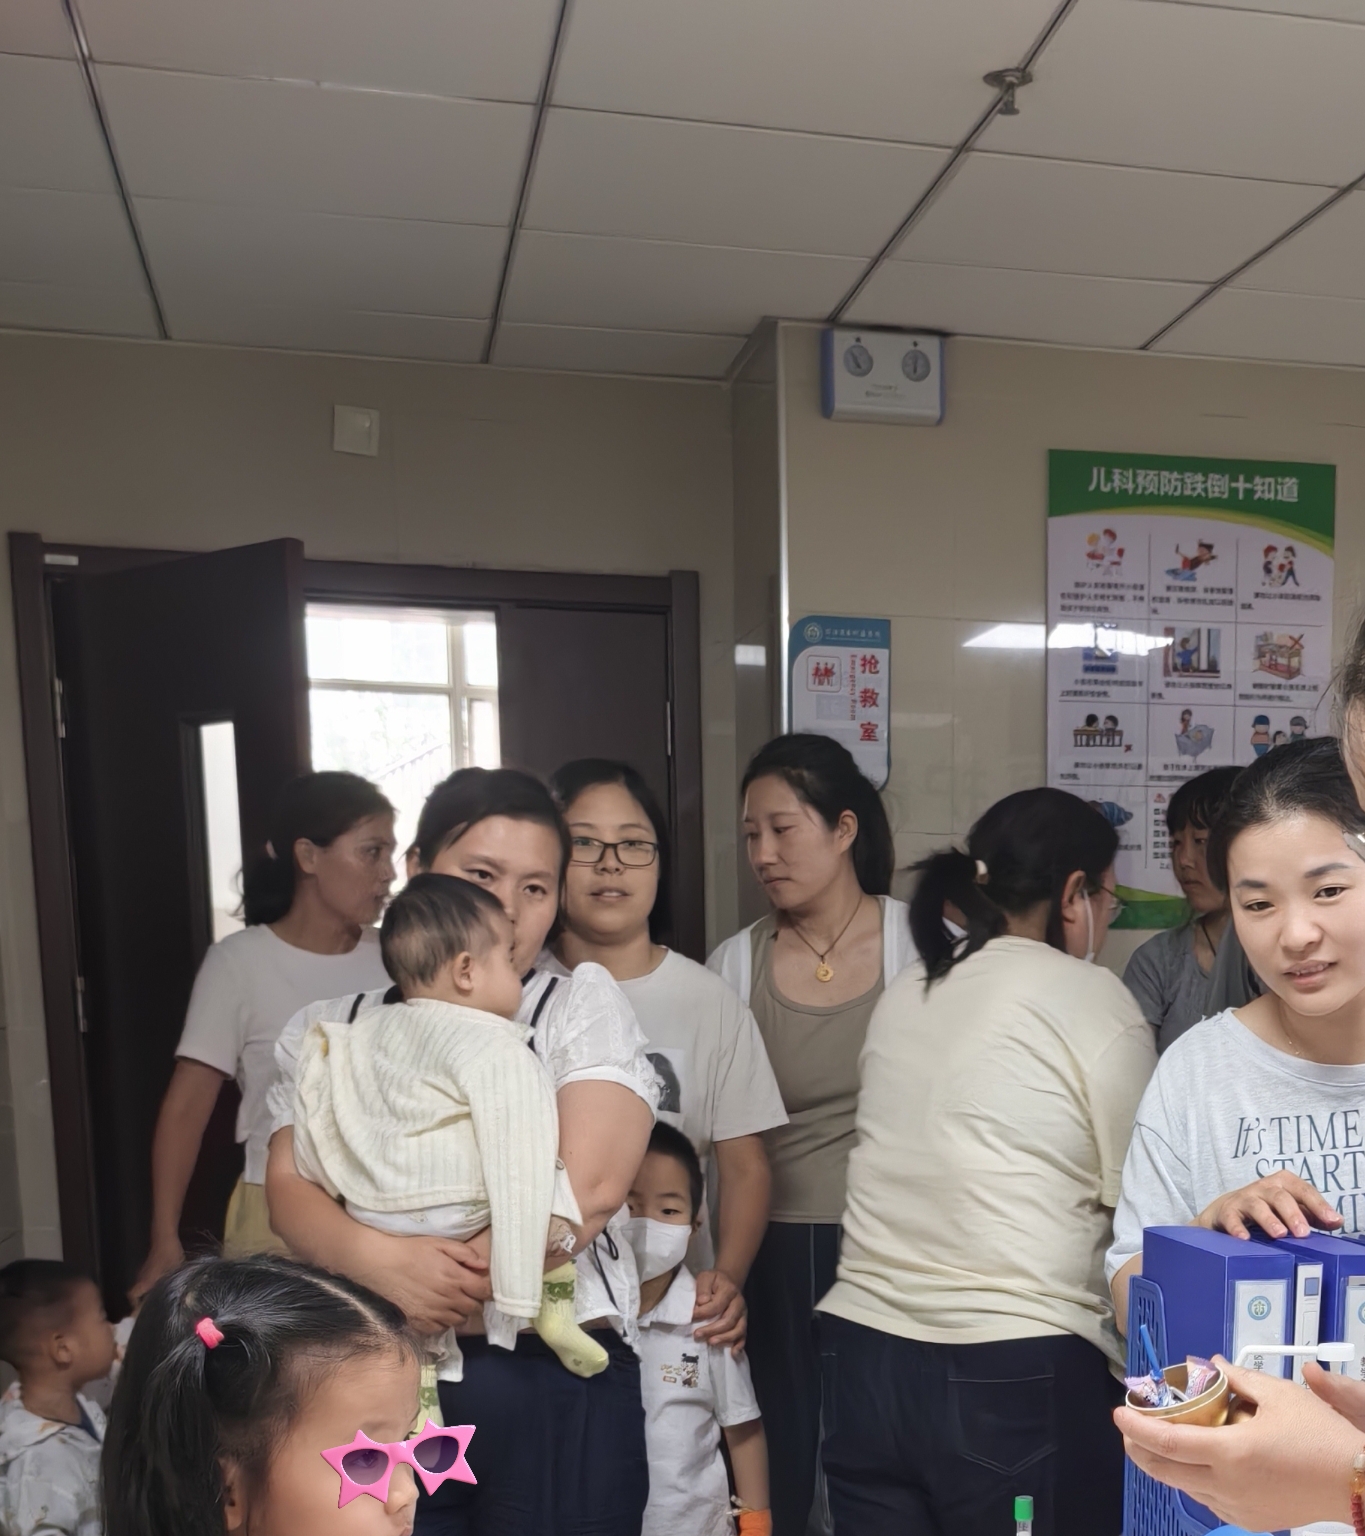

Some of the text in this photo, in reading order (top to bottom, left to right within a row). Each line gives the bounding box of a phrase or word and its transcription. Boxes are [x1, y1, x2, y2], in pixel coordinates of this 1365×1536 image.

[1088, 466, 1300, 503] 儿科预防跌倒十知道
[859, 654, 880, 742] 抢救室
[1232, 1116, 1267, 1160] It's
[1270, 1109, 1364, 1156] TIME
